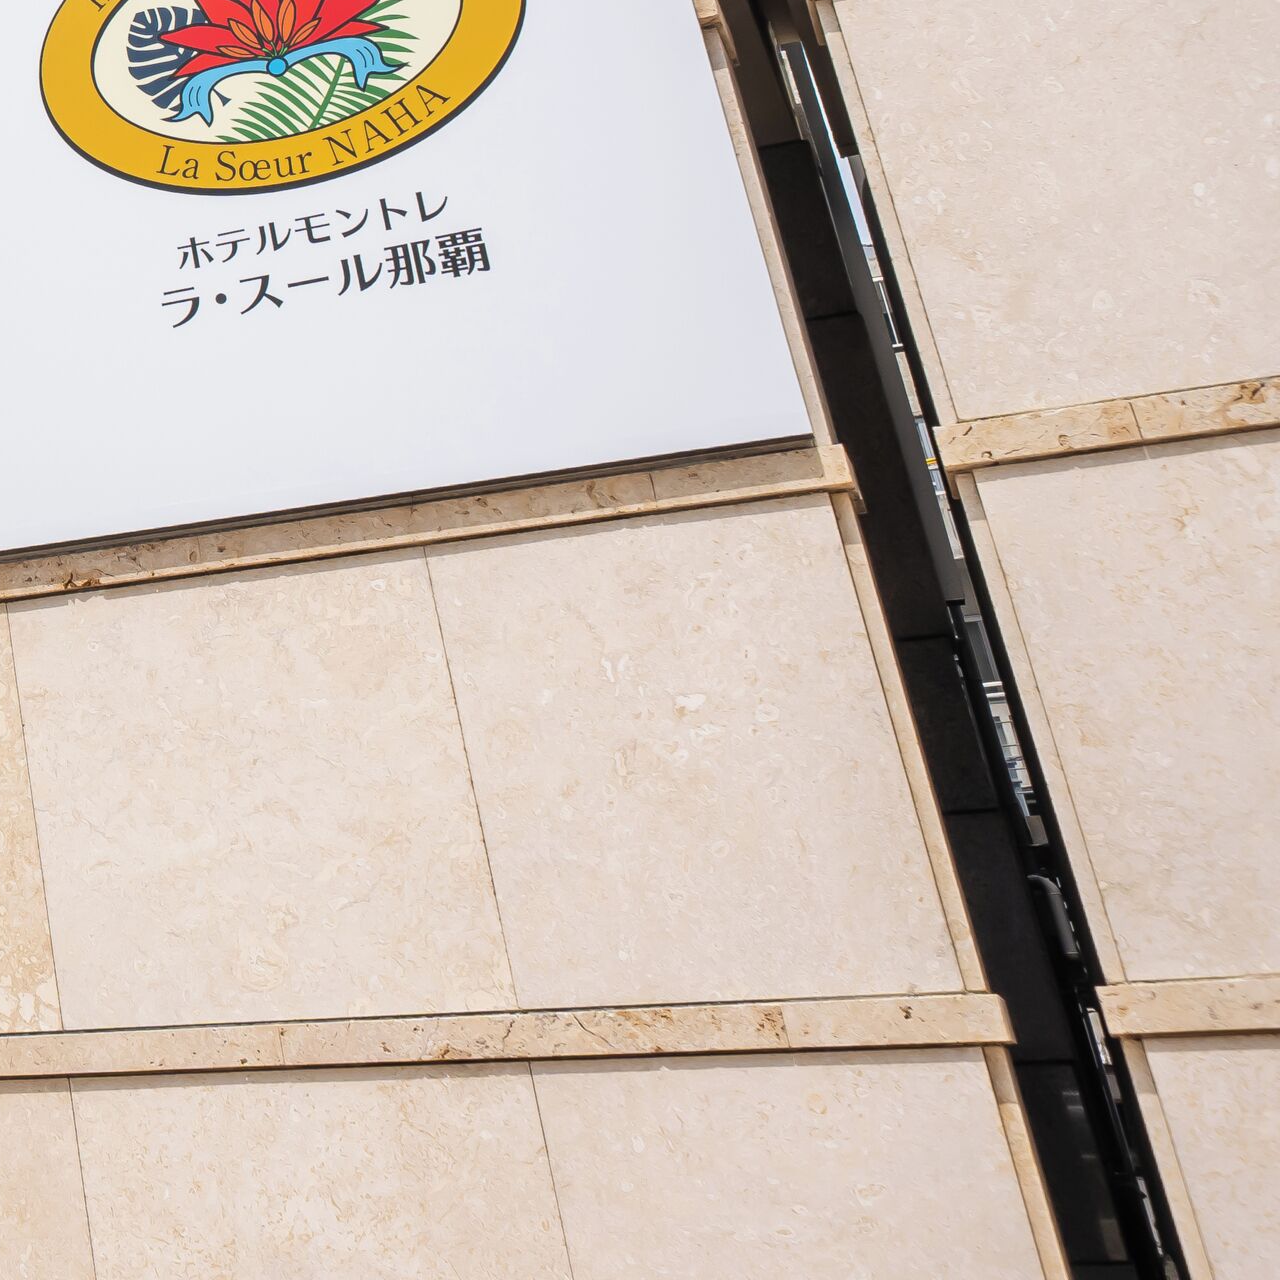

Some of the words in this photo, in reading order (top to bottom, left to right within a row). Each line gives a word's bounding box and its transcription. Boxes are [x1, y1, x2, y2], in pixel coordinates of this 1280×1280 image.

[155, 144, 200, 180] La
[214, 150, 313, 182] Sœur
[322, 80, 452, 166] NAHA
[160, 226, 492, 329] ラ・スール那覇
[176, 191, 449, 270] ホテルモントレ
